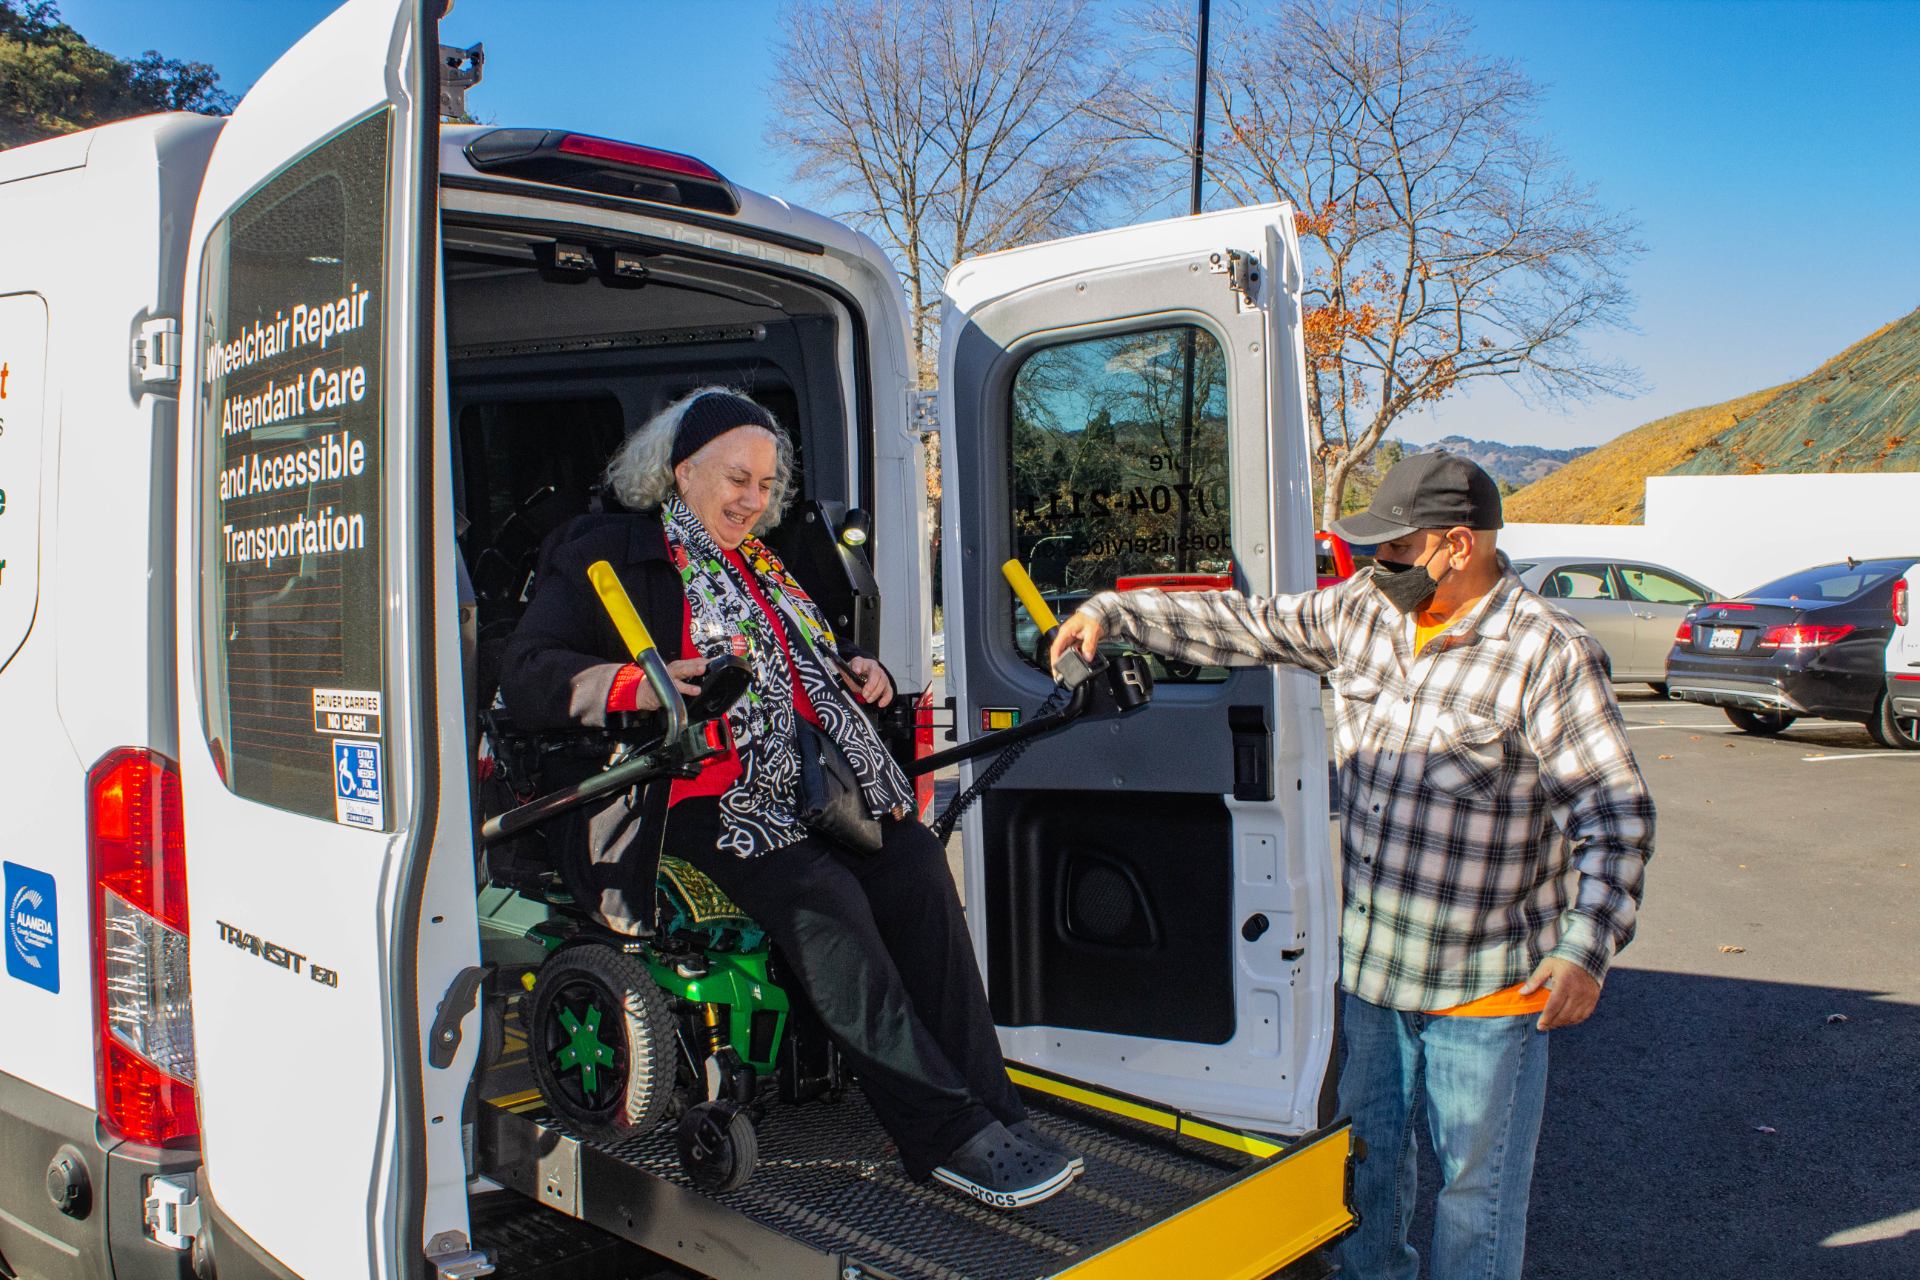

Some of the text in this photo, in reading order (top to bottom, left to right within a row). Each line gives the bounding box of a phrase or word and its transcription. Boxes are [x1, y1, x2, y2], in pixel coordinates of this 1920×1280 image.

[207, 284, 369, 383] Wheelchair Repair
[221, 363, 366, 438] Attendant Care
[220, 431, 365, 501] and Accessible
[223, 506, 365, 568] Transportation
[316, 694, 377, 711] DRIVER CARRIES
[327, 713, 367, 732] NO CASH
[357, 749, 374, 759] EXTRA
[17, 911, 53, 936] ALAMEDA
[216, 919, 307, 975] TRANSIT
[970, 1184, 1017, 1207] crocs
